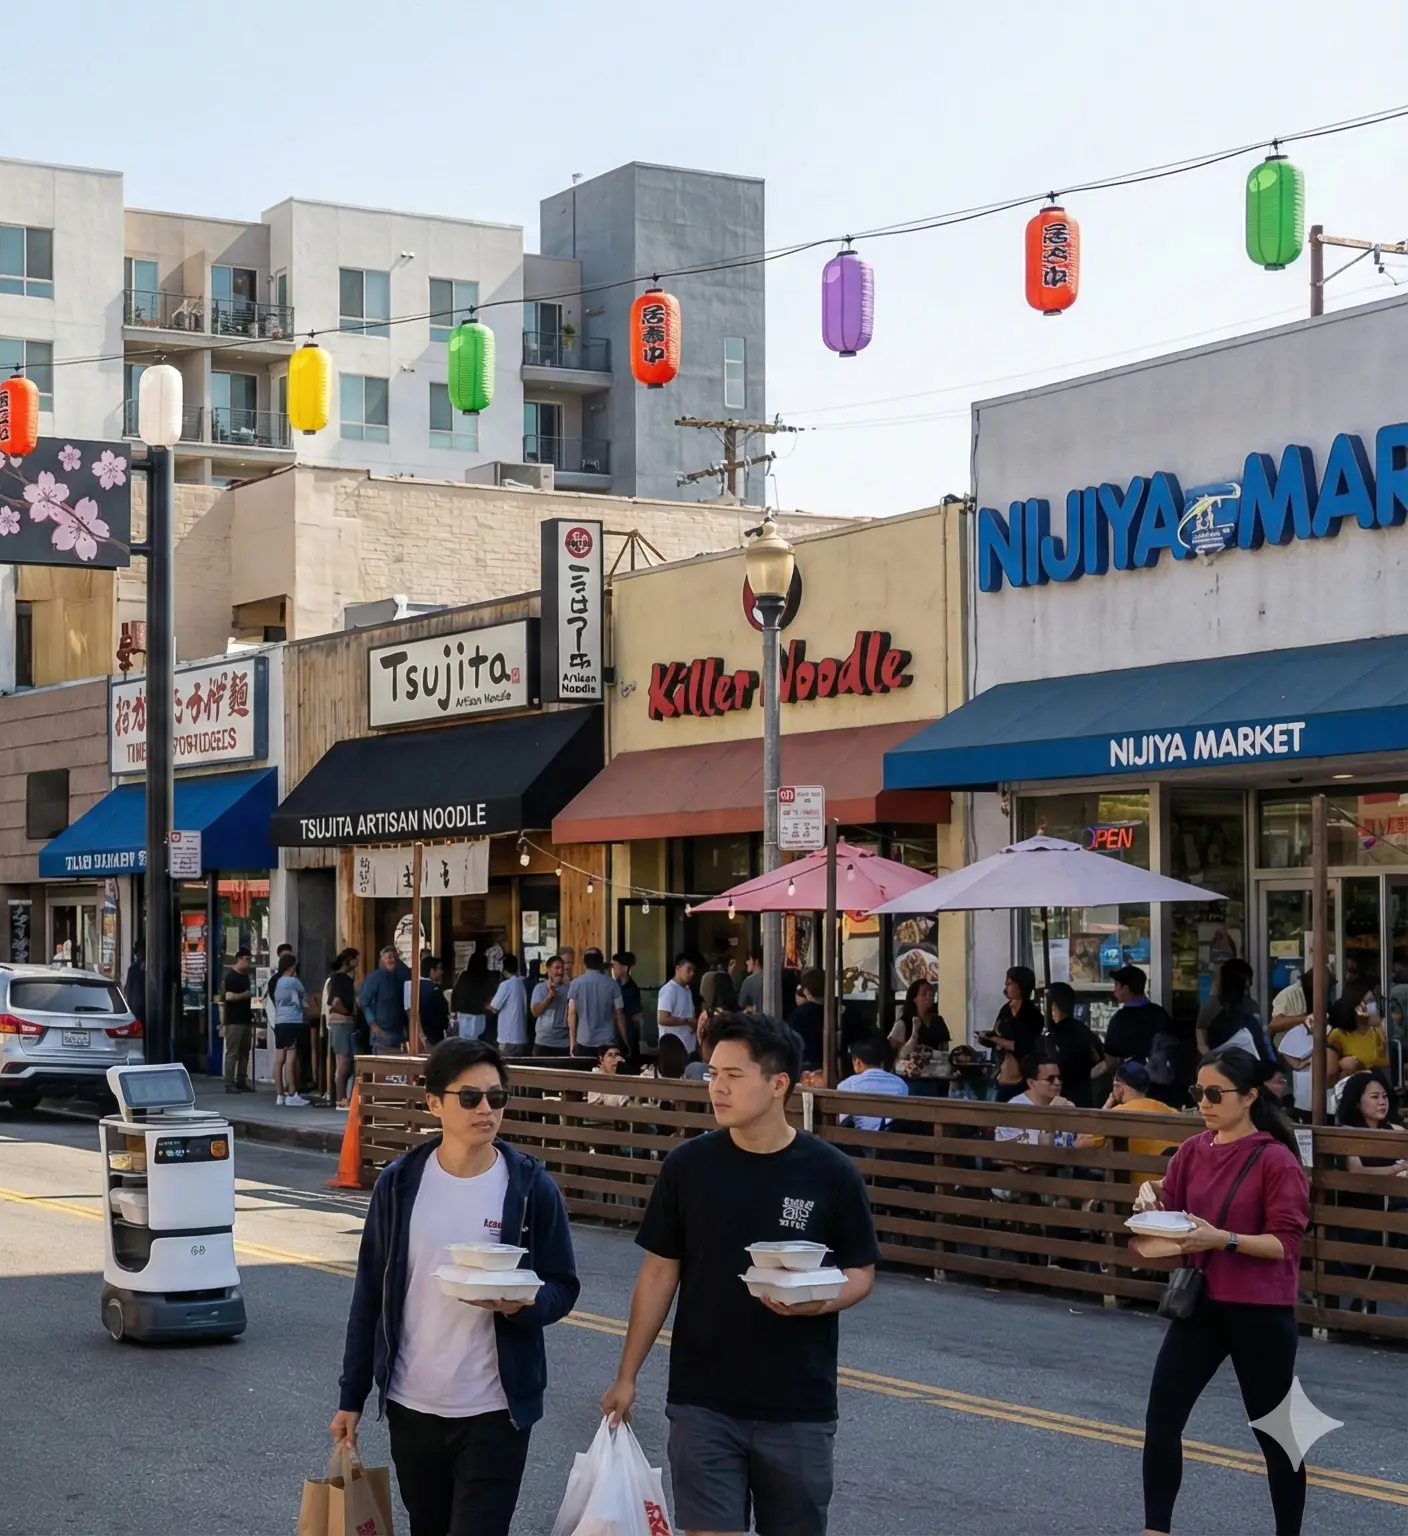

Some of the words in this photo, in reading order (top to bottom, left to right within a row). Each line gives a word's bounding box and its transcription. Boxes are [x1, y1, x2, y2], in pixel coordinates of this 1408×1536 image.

[979, 471, 1195, 592] NIJIYA
[380, 641, 511, 711] Tsujita
[648, 656, 759, 721] Killer
[1110, 732, 1187, 767] NIJIYA
[1193, 722, 1305, 760] MARKET
[300, 816, 353, 840] TSUJITA
[357, 810, 418, 835] ARTISAN
[423, 803, 487, 830] NOODLE
